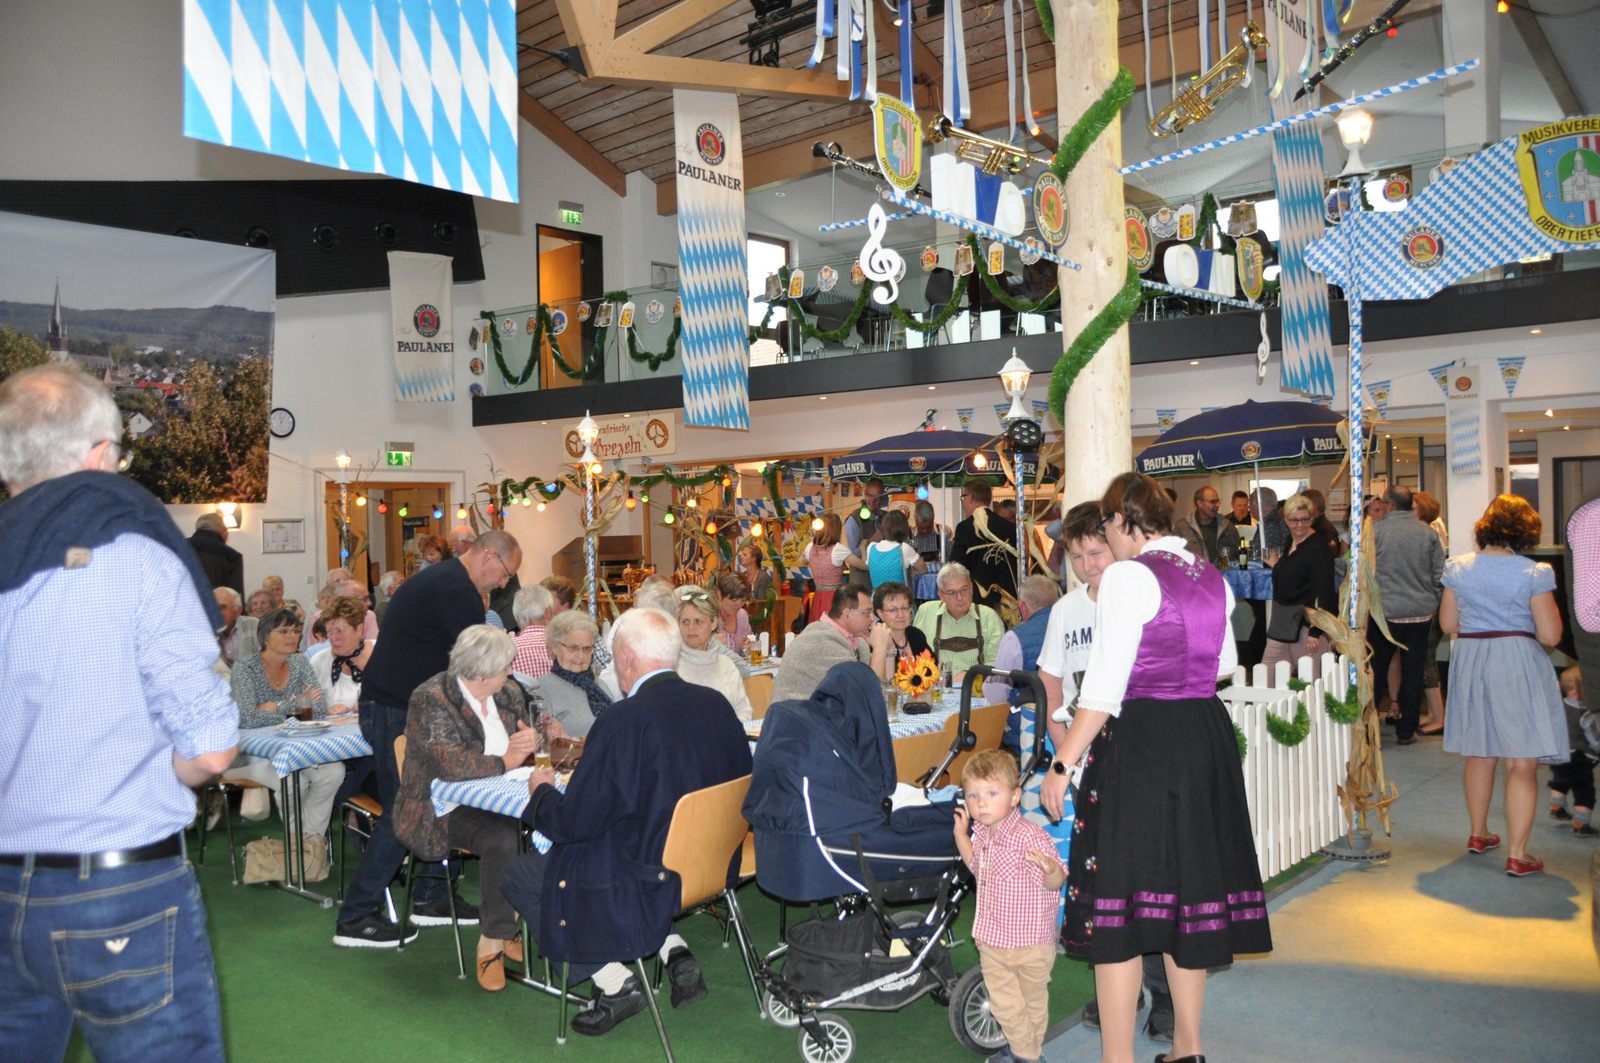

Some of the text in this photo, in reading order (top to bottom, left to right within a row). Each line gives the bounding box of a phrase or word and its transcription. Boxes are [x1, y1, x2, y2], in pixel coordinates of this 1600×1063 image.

[678, 160, 742, 192] PAULANER
[1037, 176, 1068, 211] PAULANER
[1124, 209, 1148, 230] LANER
[1402, 228, 1440, 246] PAULANER
[831, 462, 867, 477] PAULANER
[1143, 454, 1195, 472] PAULANER
